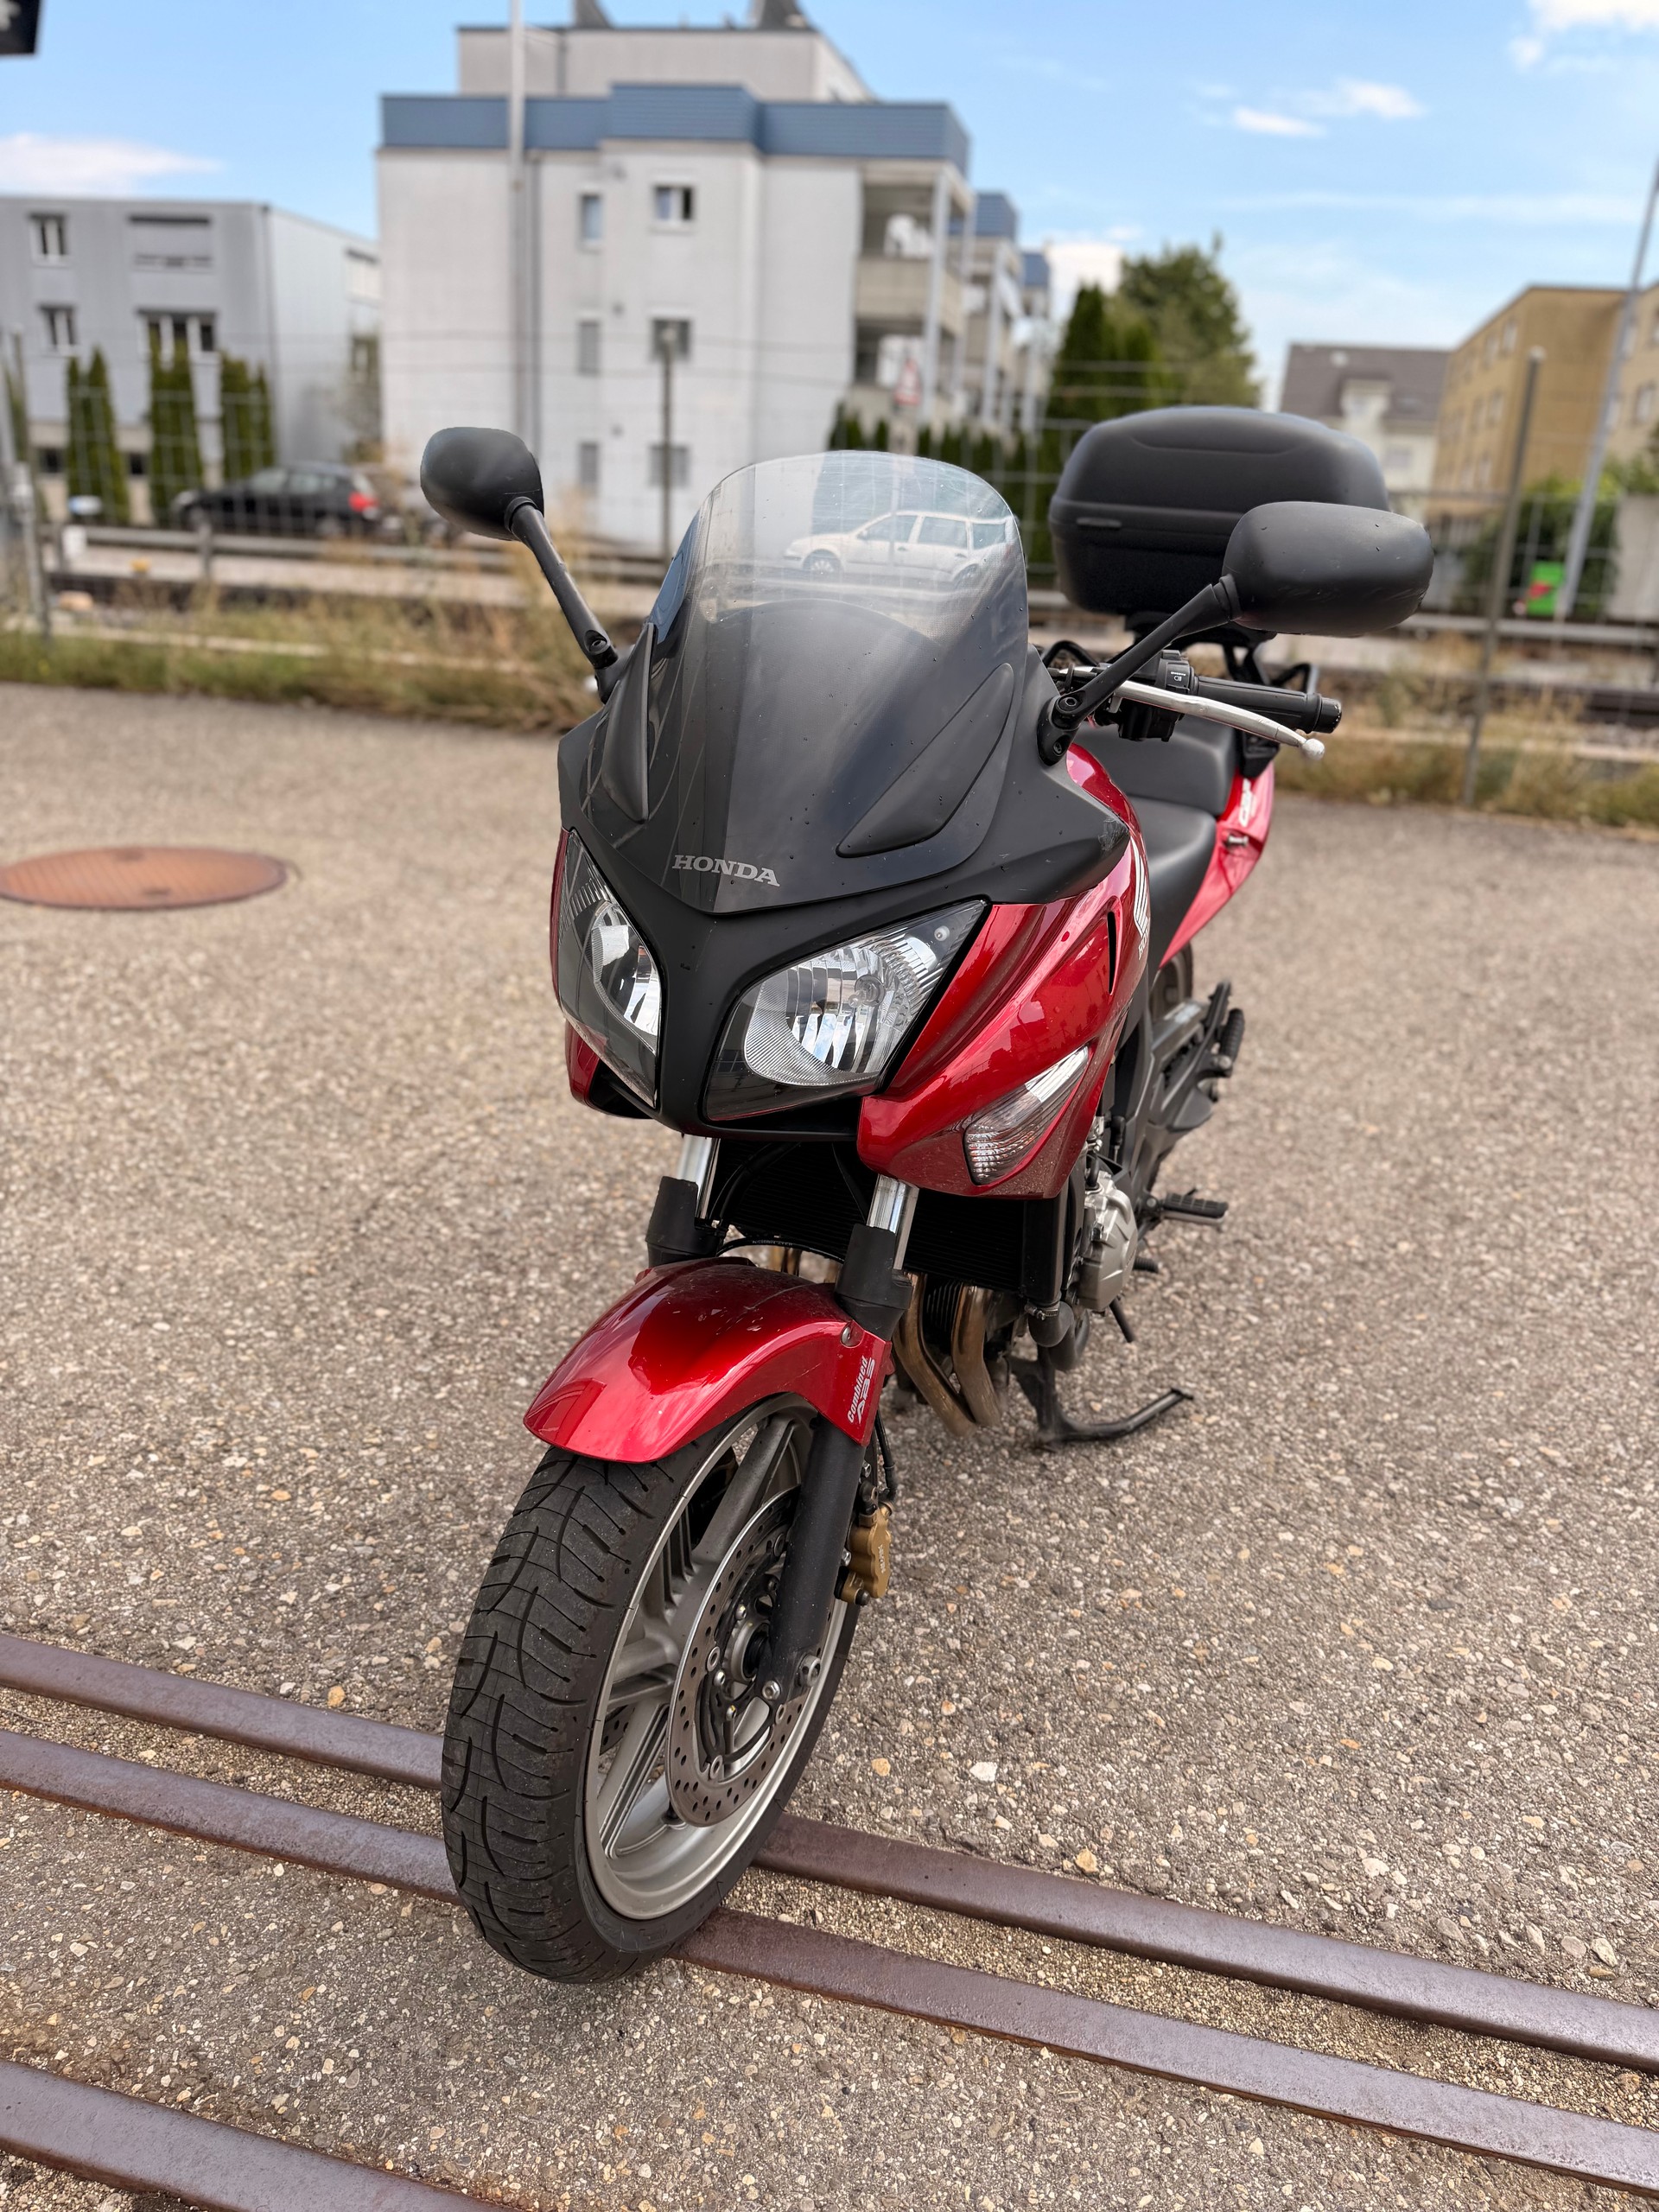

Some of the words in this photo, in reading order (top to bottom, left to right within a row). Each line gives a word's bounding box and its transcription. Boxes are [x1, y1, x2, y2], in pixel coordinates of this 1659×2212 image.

[671, 855, 781, 887] HONDA
[847, 1355, 868, 1423] Combined
[856, 1357, 875, 1425] ABS
